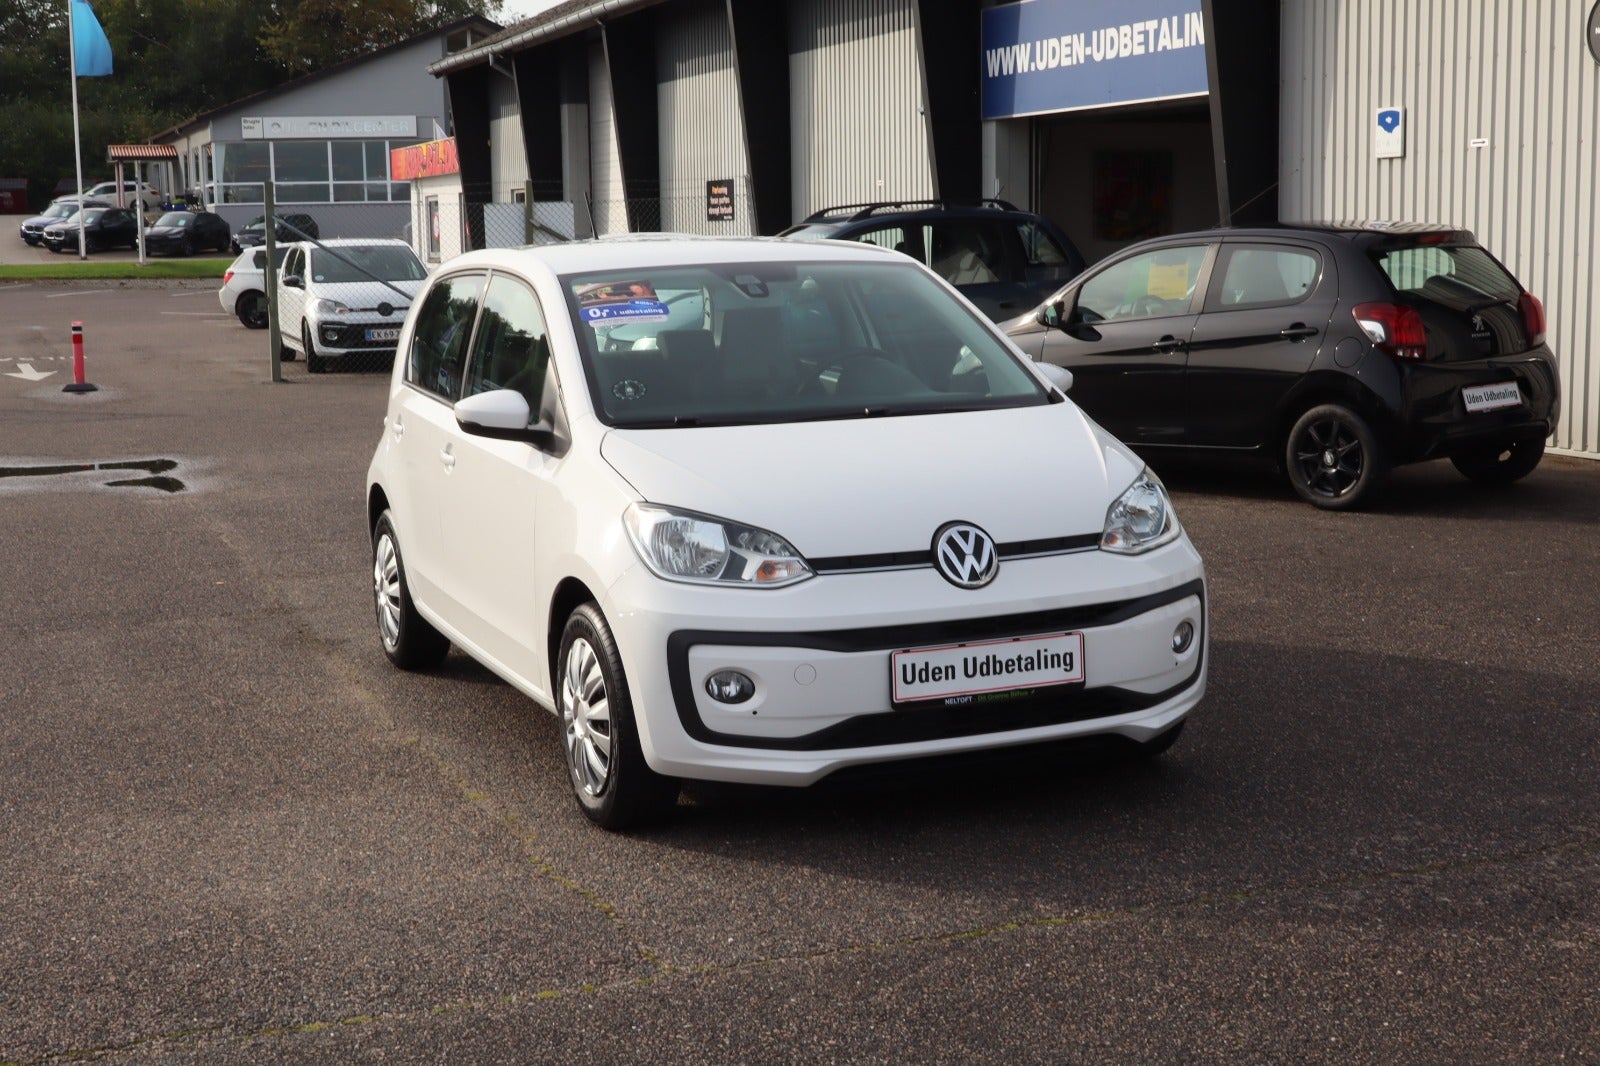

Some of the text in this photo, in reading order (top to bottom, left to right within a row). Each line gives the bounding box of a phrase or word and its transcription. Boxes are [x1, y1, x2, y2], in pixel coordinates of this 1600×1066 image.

[986, 11, 1205, 78] WWW.UDEN-UDBETALIN
[902, 648, 1074, 685] Uden Udbetaling
[945, 695, 972, 706] NELTOFT
